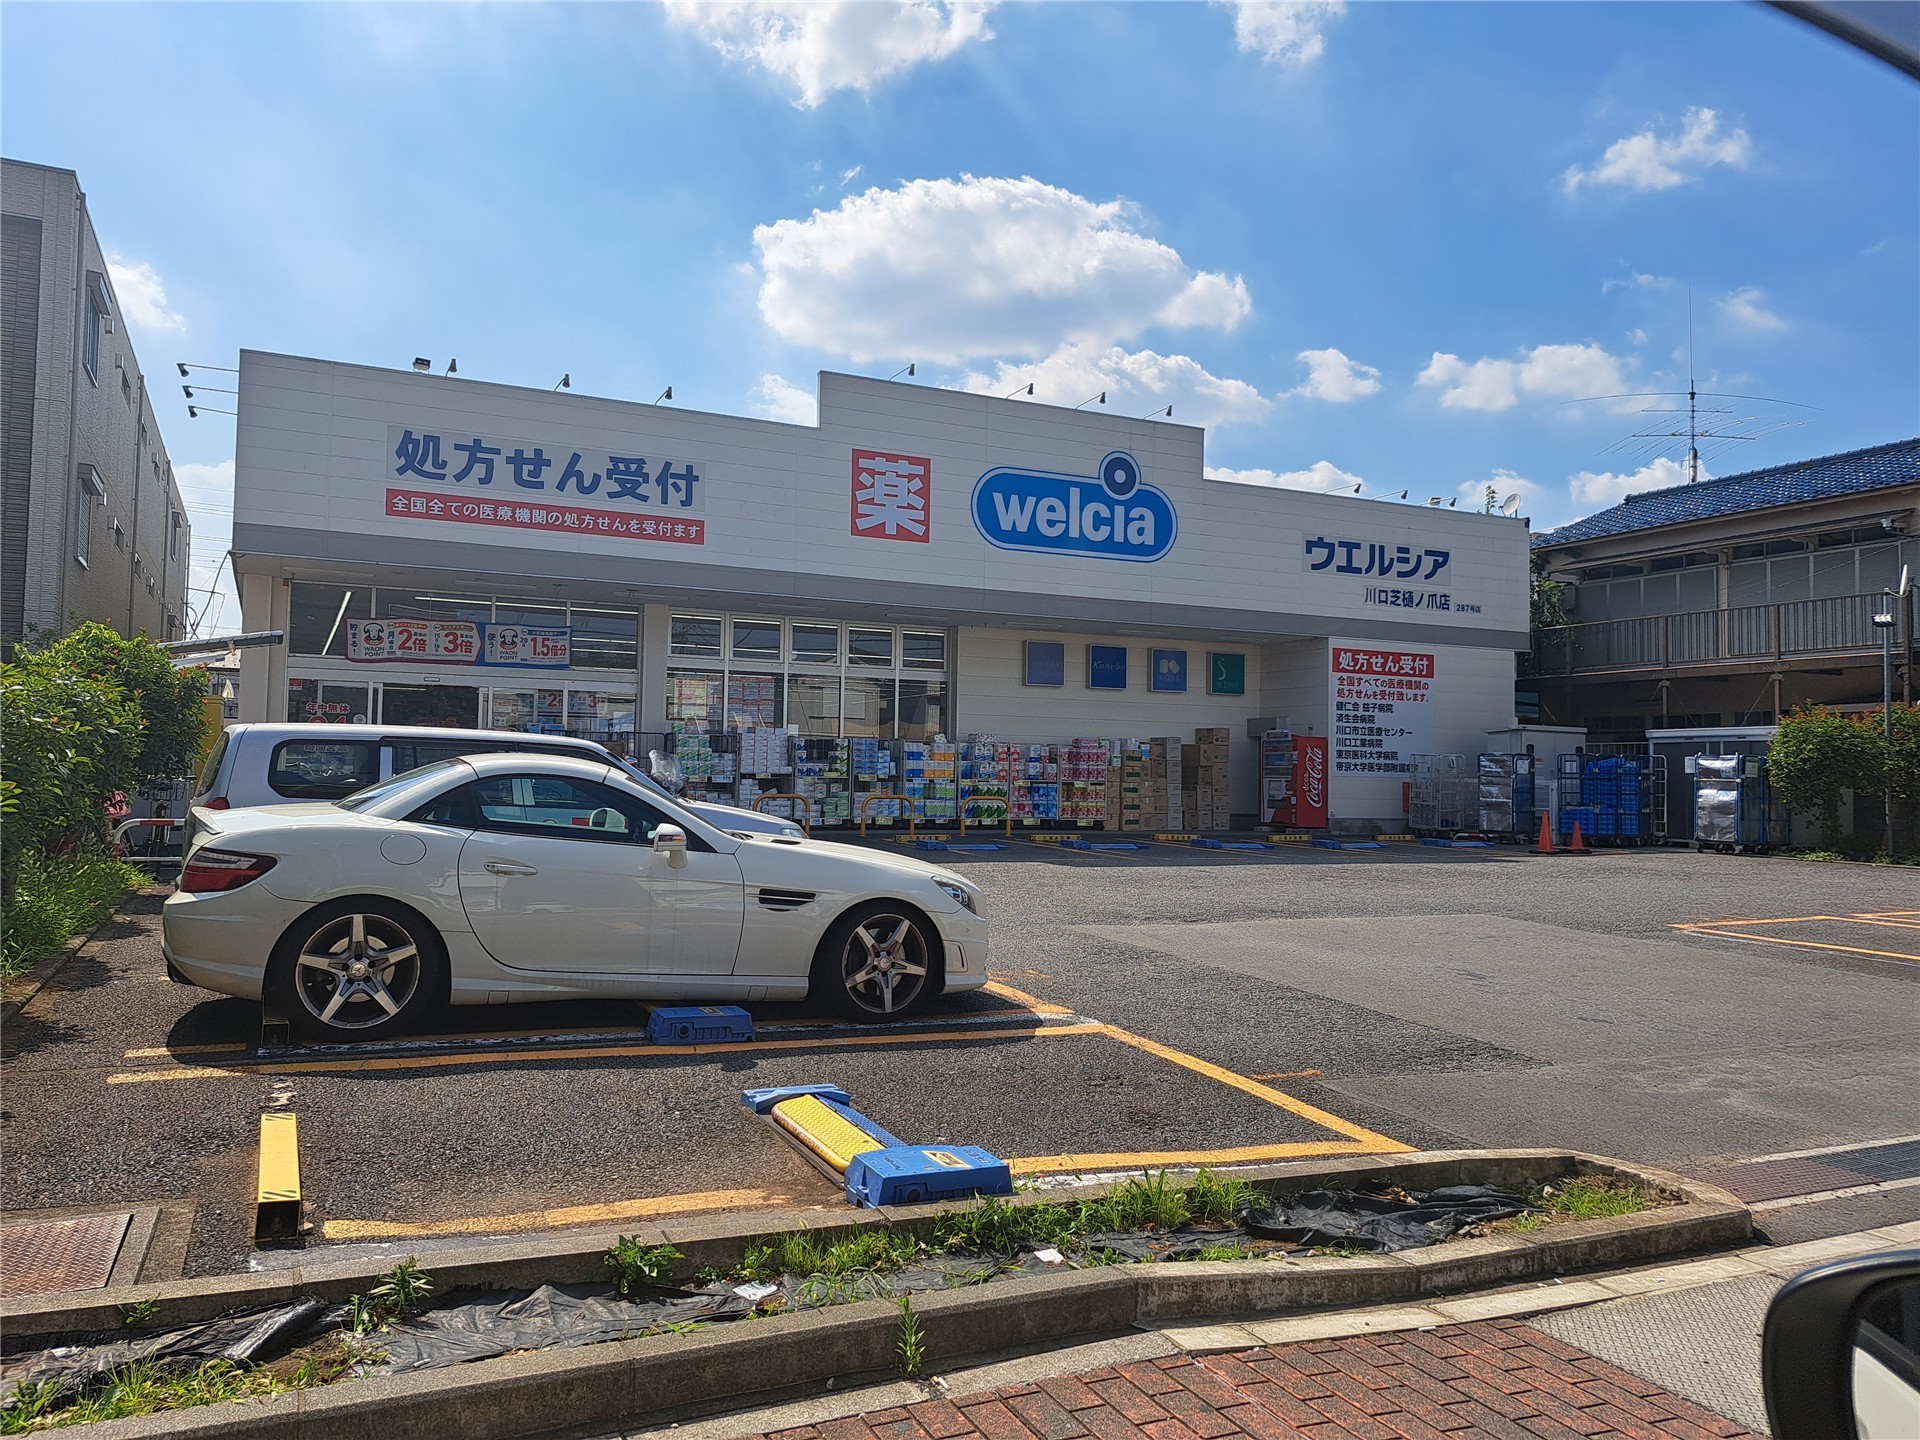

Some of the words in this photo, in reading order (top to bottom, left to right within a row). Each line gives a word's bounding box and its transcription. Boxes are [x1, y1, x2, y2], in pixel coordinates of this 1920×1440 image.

[394, 429, 700, 507] 処方せん受付
[854, 456, 927, 537] 薬
[391, 494, 702, 540] 全国全ての医療機関の処方せんを受付ます
[991, 486, 1155, 547] welcia
[1305, 536, 1450, 580] ウエルシア
[1364, 587, 1450, 611] 川口芝樋ノ爪店
[1456, 603, 1482, 614] 287号店
[1338, 651, 1429, 675] 処方せん受付
[1337, 676, 1429, 690] 全国すべての医療機関の
[1336, 688, 1429, 703] 処方せんを受付致します。
[306, 702, 350, 713] 年中無休
[1362, 702, 1394, 713] 益子病院
[1335, 713, 1376, 724] 済生会病院
[1335, 725, 1413, 737] 川口市立医療センター
[1335, 737, 1383, 749] 川口工業病院
[1335, 749, 1399, 761] 東京医科大学病院
[1305, 743, 1323, 808] Coca-Cola
